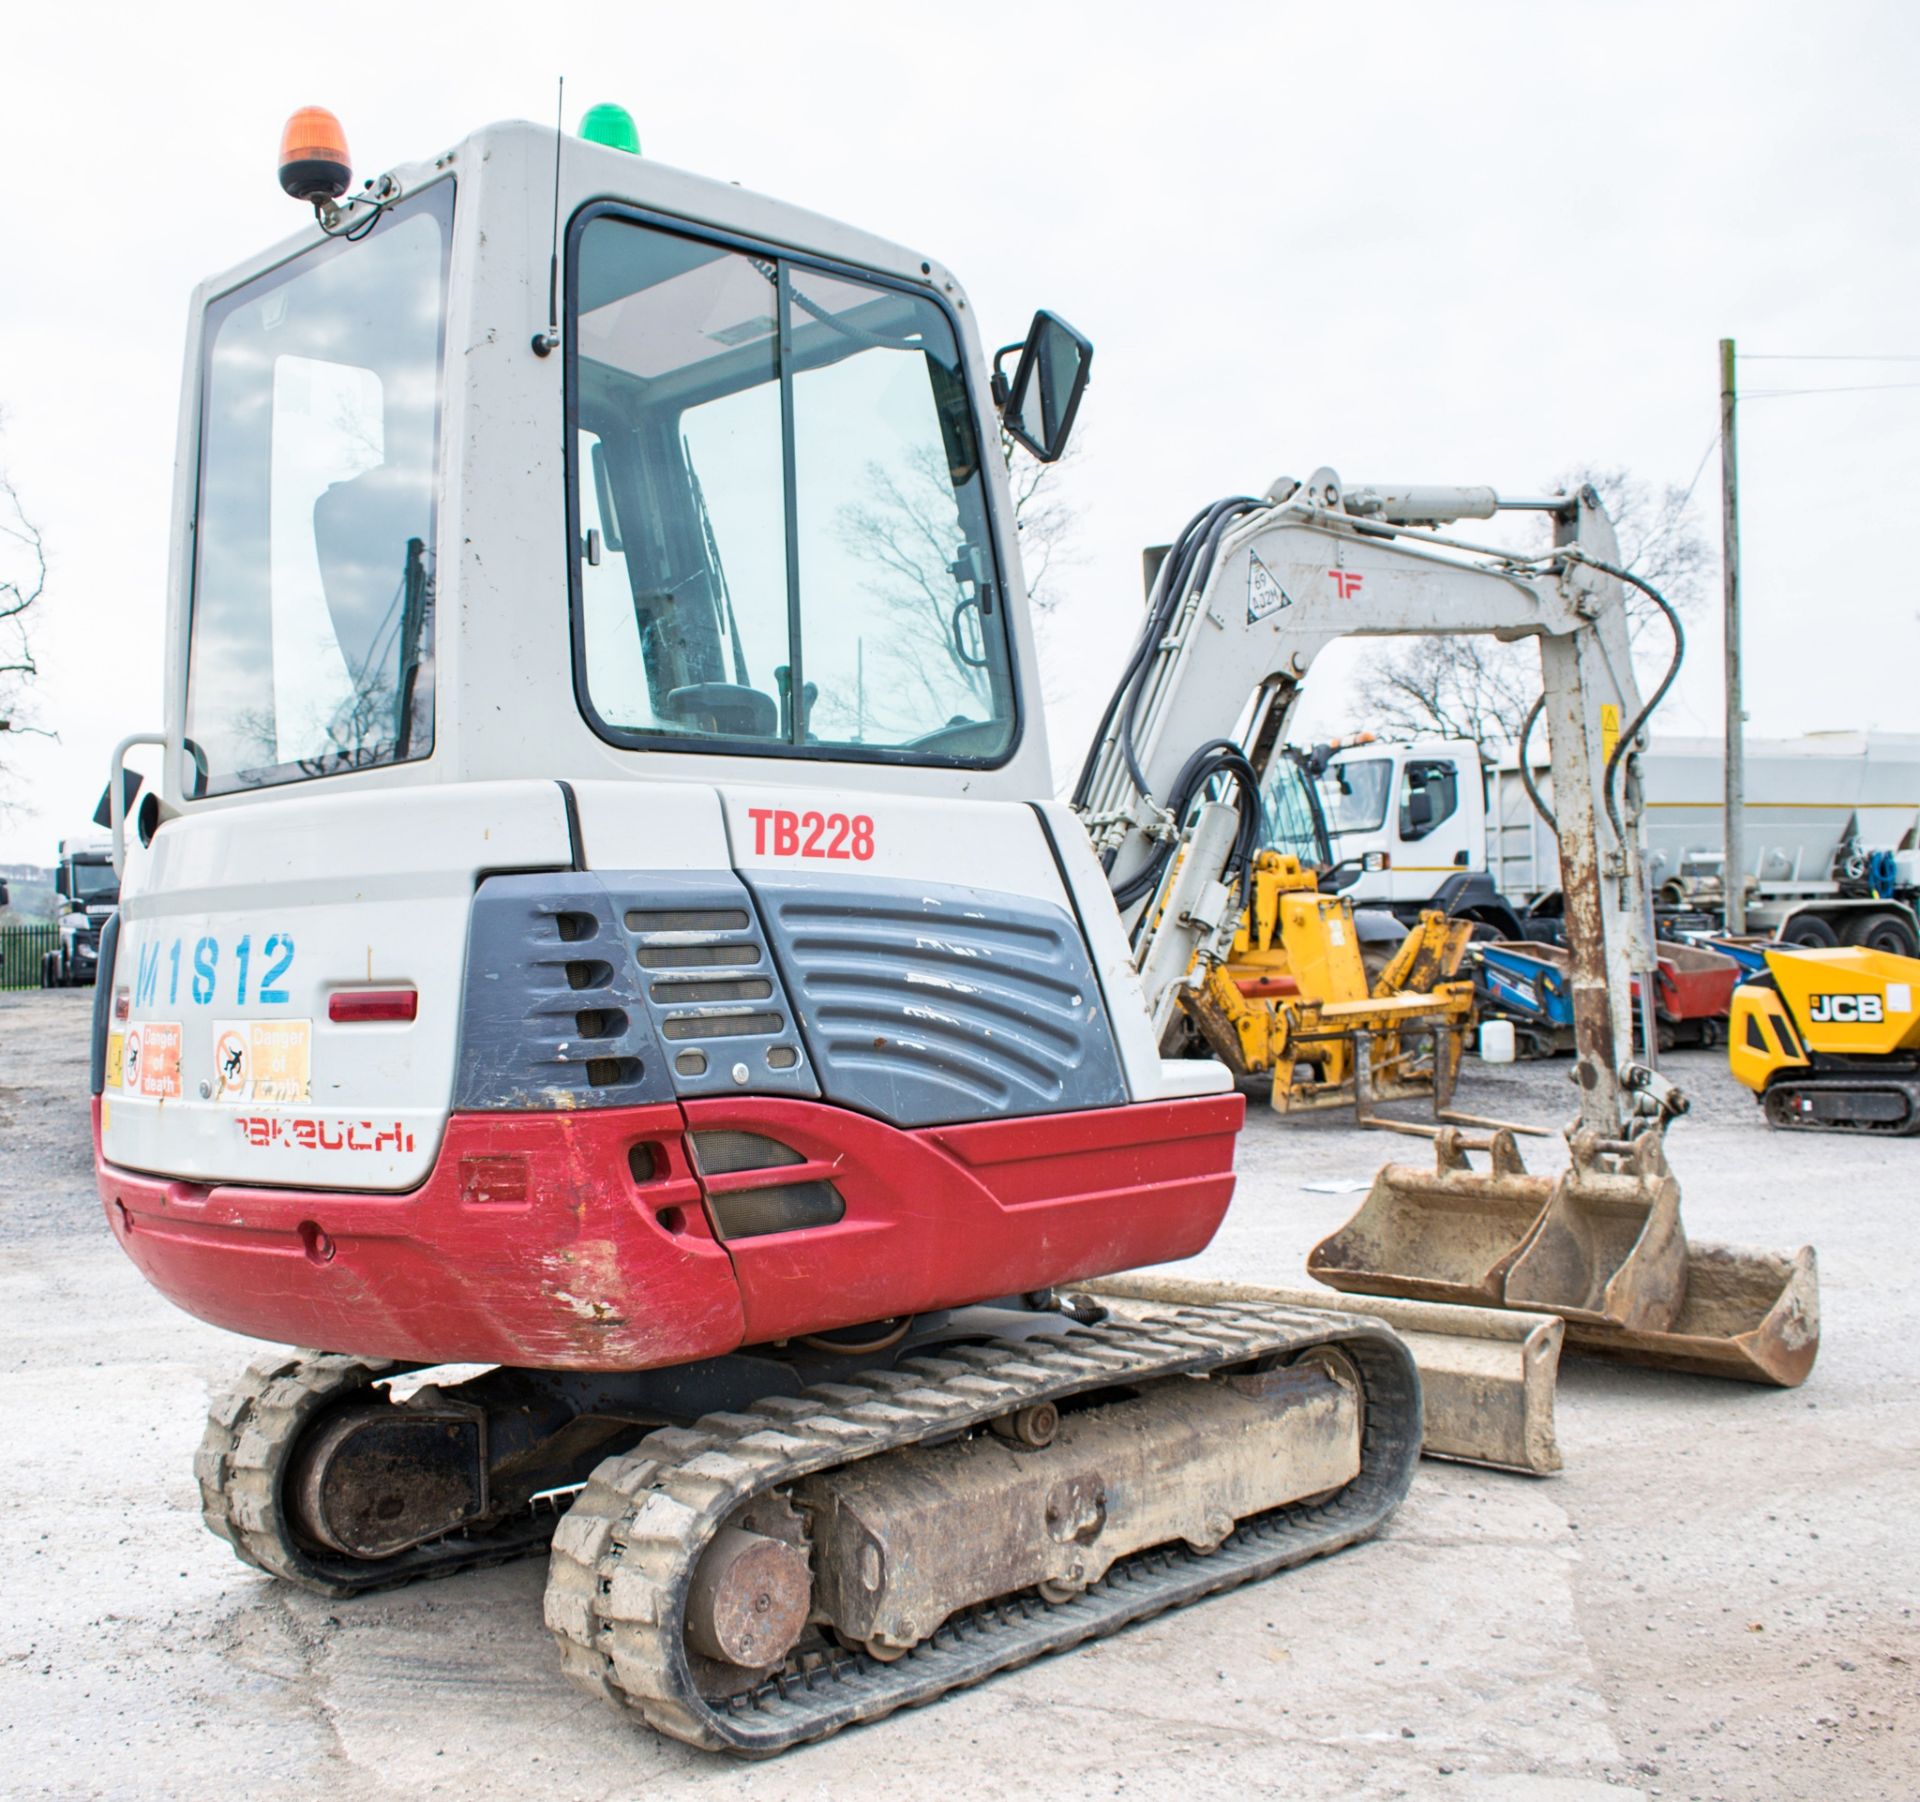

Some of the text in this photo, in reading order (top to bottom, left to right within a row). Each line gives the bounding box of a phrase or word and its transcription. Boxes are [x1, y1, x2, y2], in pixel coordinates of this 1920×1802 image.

[748, 808, 875, 861] TB228
[1811, 995, 1883, 1022] JCB
[145, 1028, 177, 1049] Danger
[255, 1026, 304, 1050] Danger
[144, 1074, 174, 1093] death
